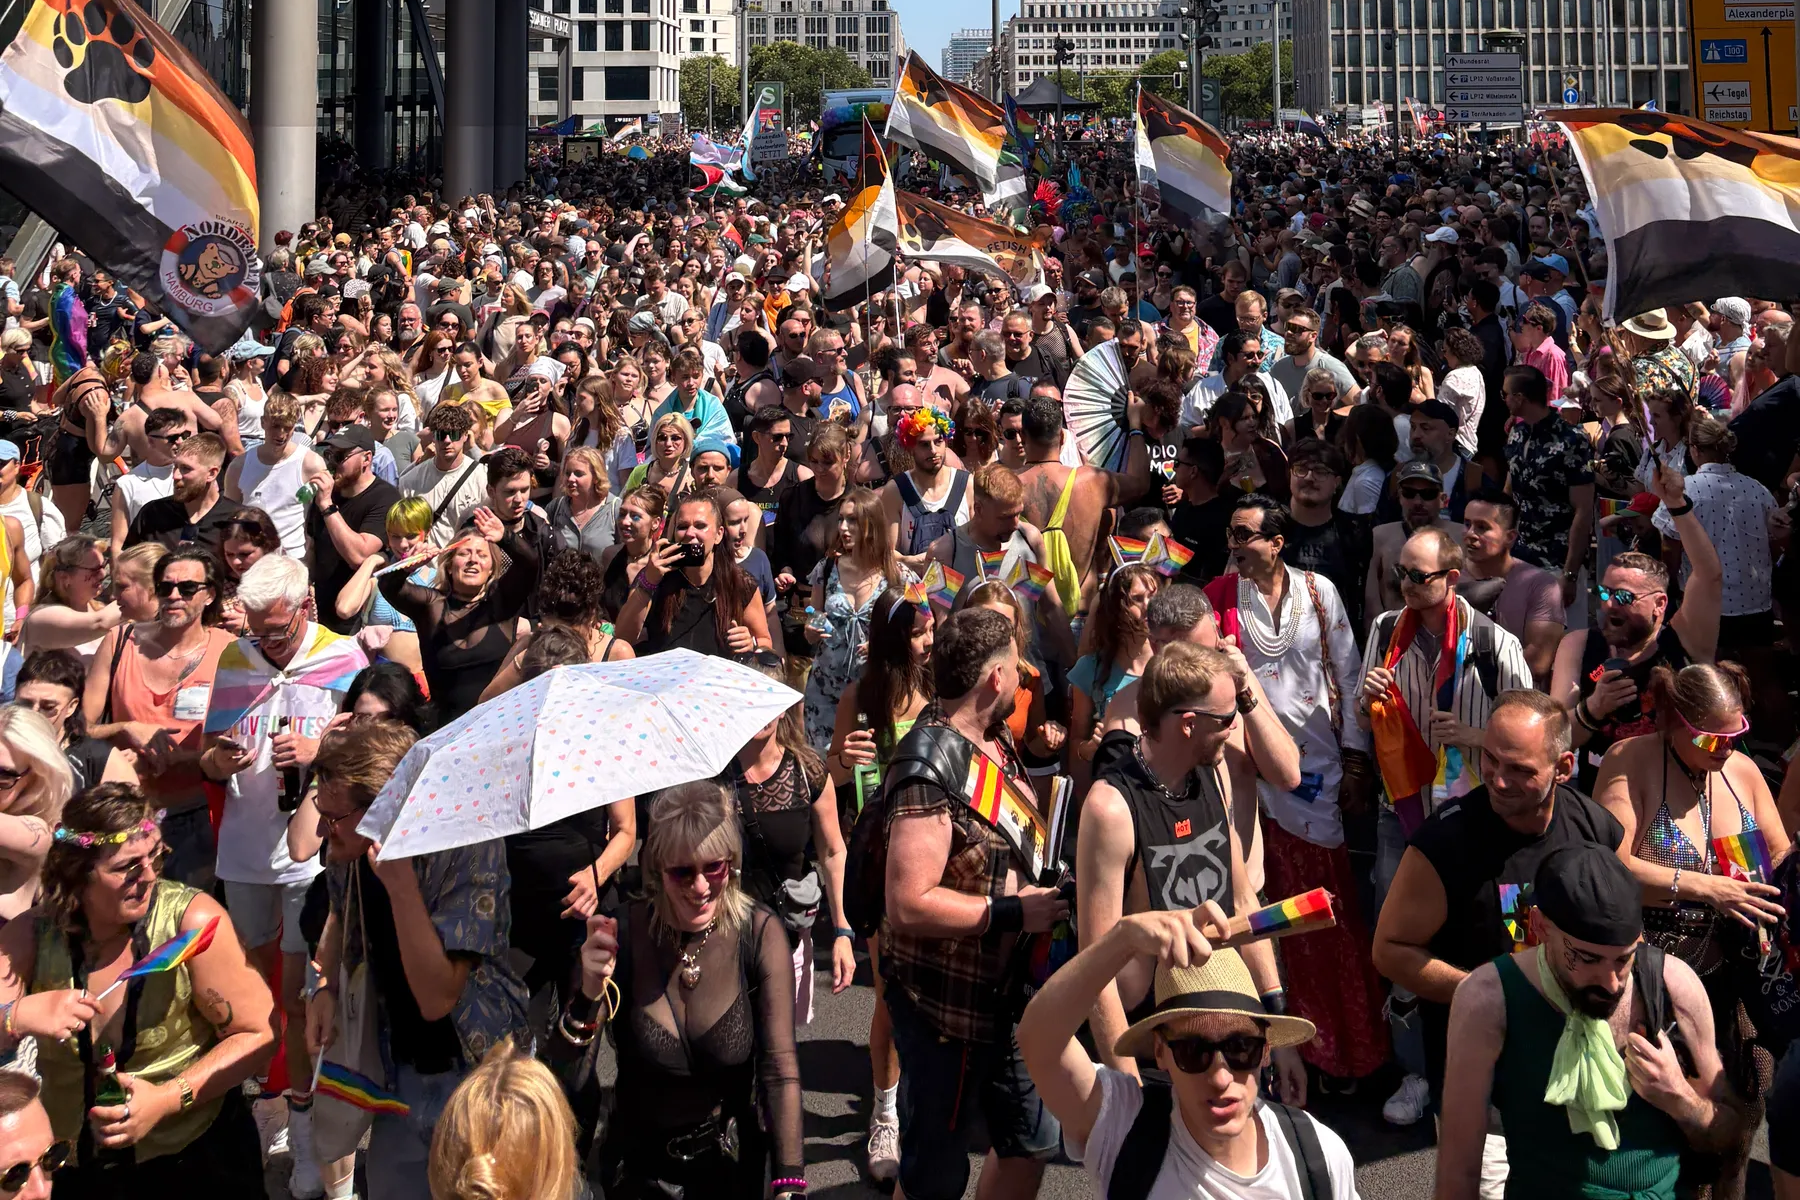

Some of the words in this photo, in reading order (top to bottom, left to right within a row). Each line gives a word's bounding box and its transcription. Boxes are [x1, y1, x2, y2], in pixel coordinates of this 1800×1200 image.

[761, 86, 776, 104] S
[1201, 83, 1215, 101] S
[1727, 87, 1748, 100] Tegel
[1709, 109, 1748, 120] Reichstag
[759, 150, 781, 159] JETZT
[987, 240, 1027, 254] FETISH
[165, 271, 214, 312] HAMBURG
[1145, 444, 1177, 459] DIO
